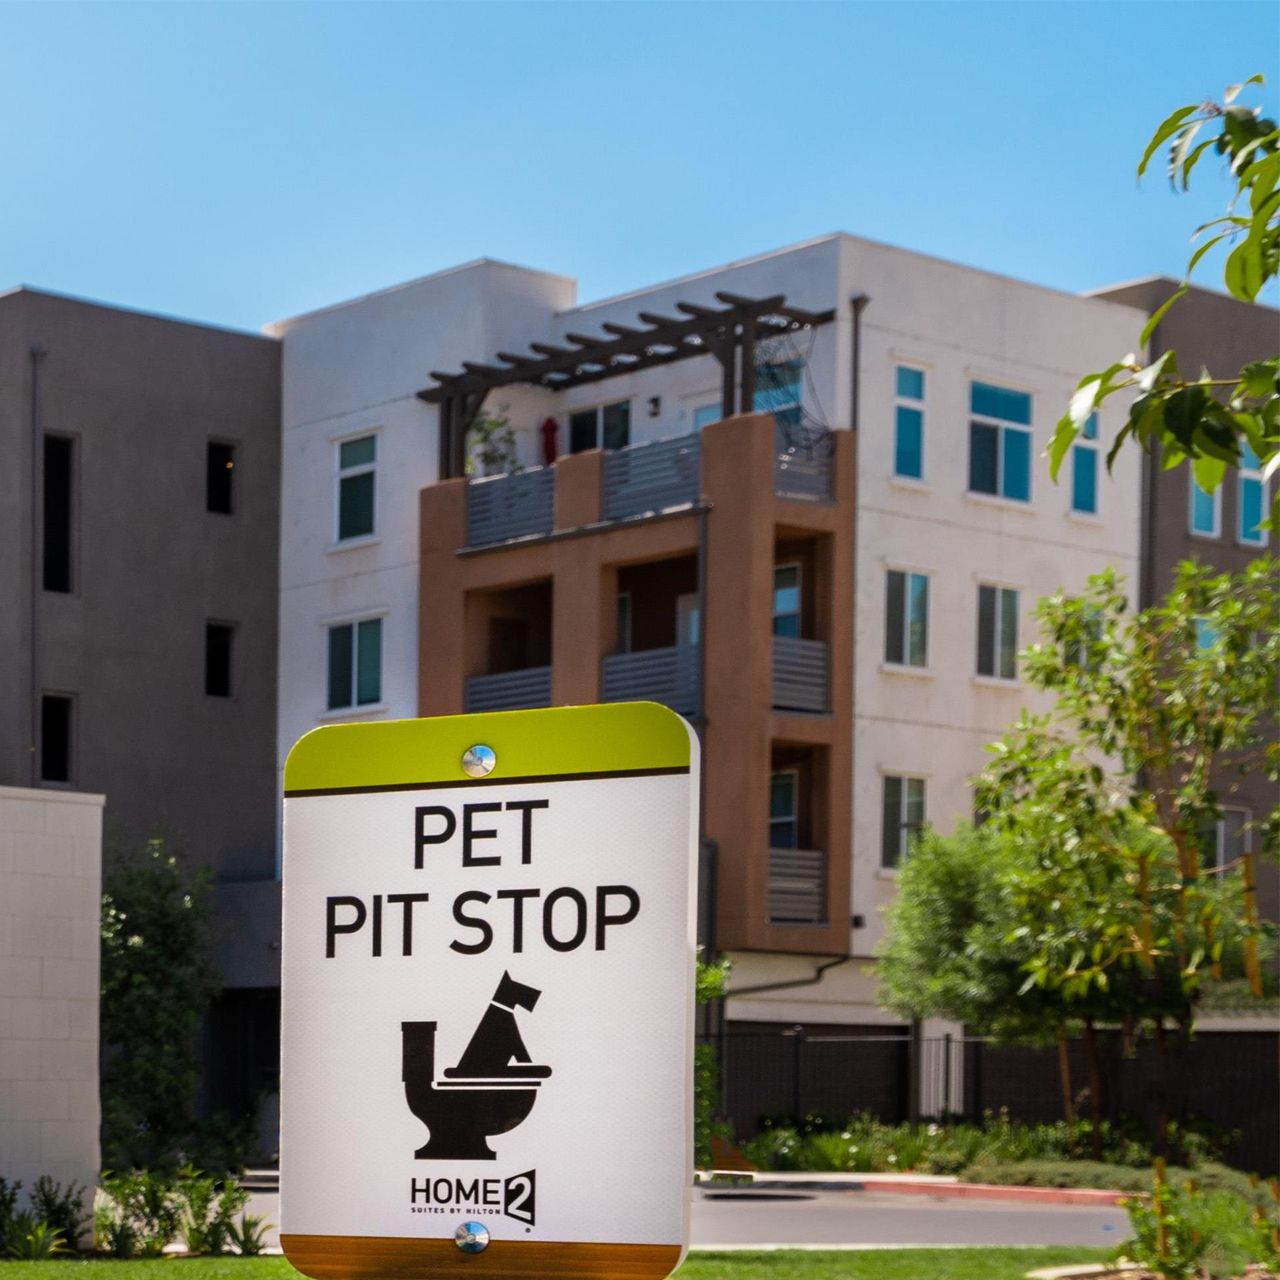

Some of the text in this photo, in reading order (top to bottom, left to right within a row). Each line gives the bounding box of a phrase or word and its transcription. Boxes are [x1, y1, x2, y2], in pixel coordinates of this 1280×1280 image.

[413, 799, 550, 870] PET
[325, 884, 641, 959] PIT STOP
